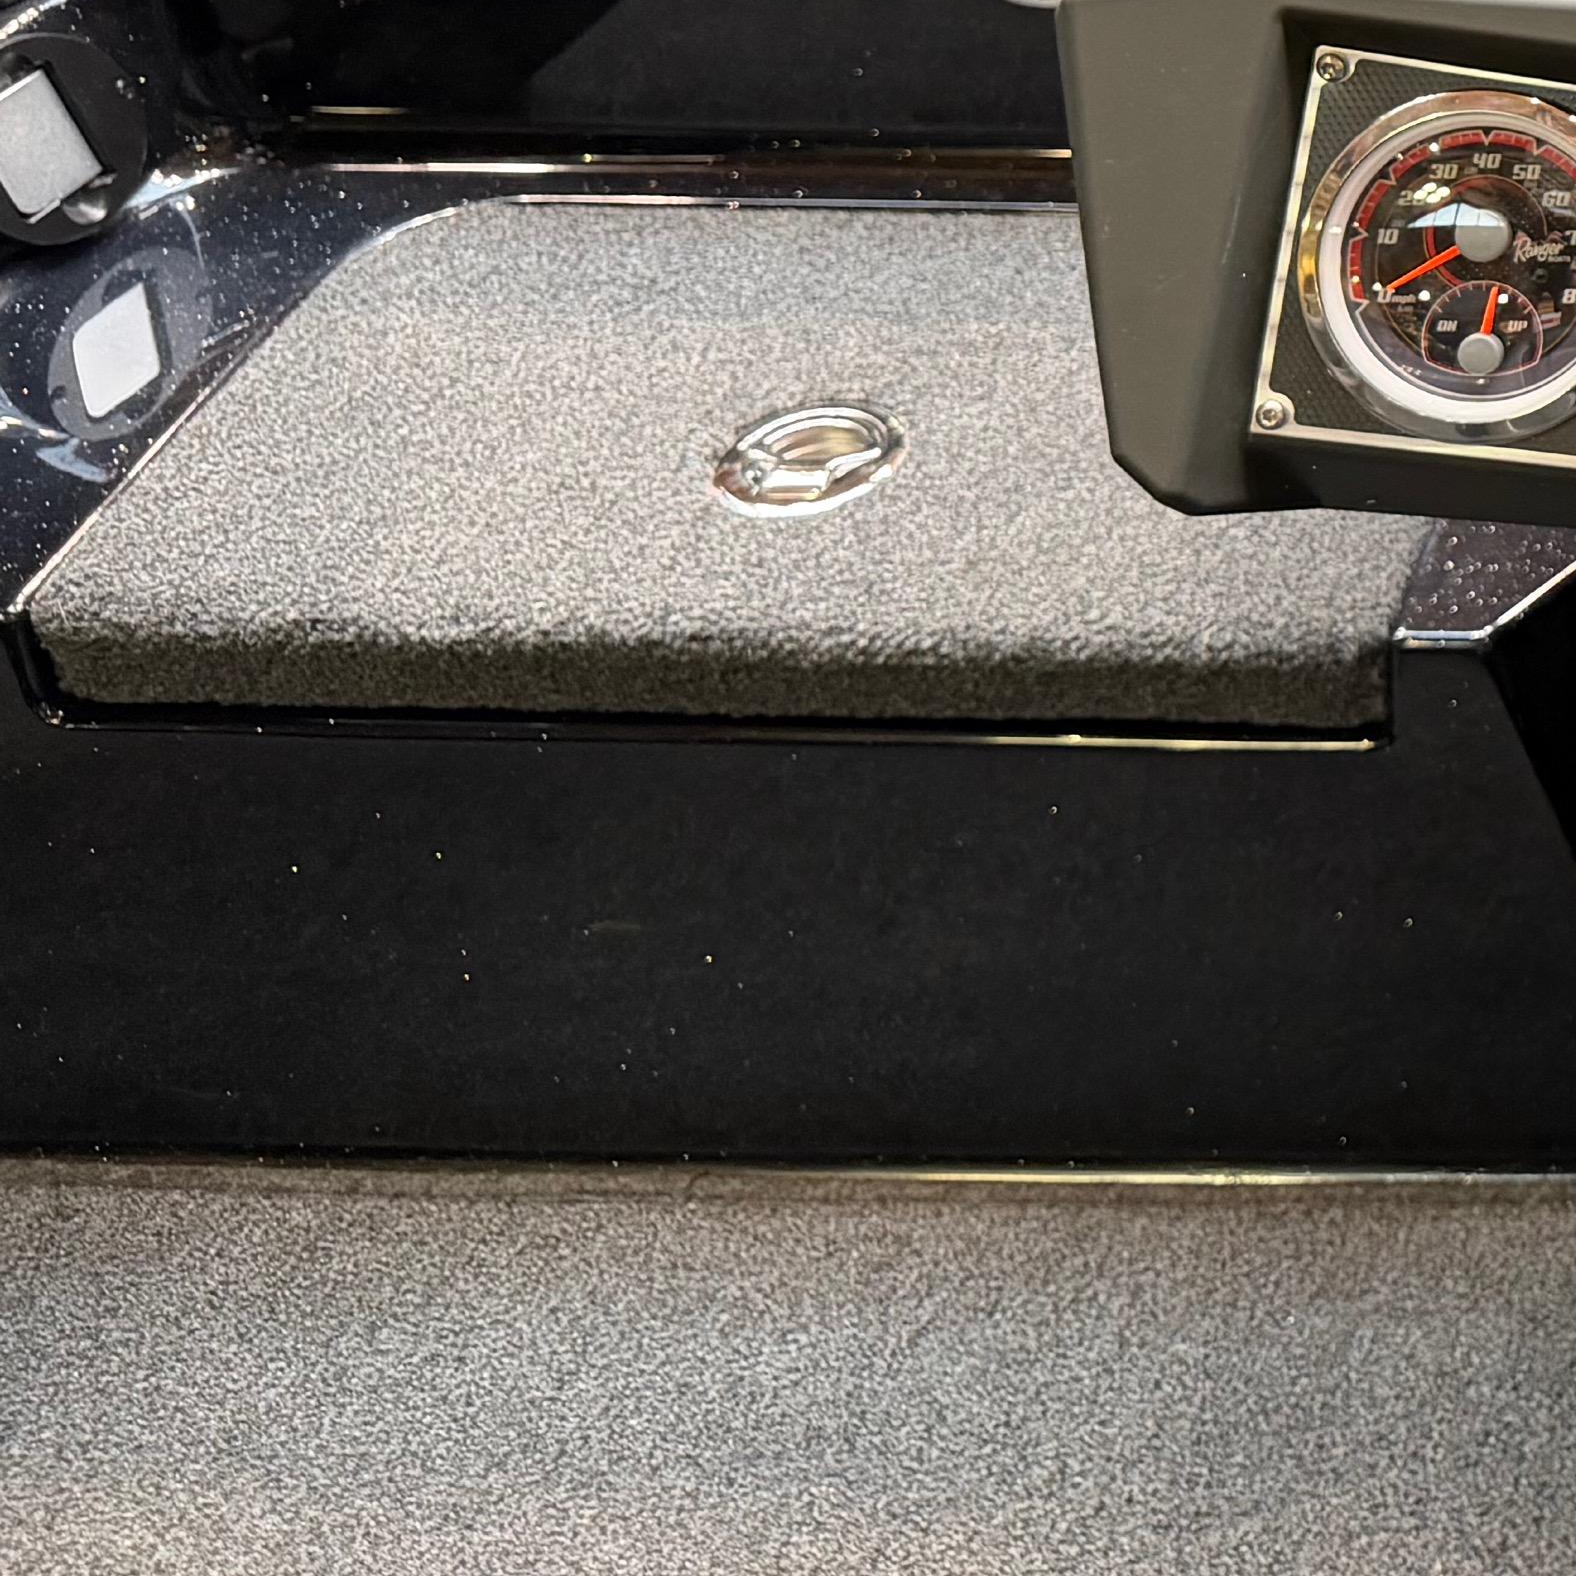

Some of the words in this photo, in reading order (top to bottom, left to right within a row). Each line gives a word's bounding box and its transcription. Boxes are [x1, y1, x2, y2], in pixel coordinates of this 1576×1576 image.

[1472, 153, 1503, 169] 40
[1429, 163, 1459, 180] 30
[1512, 164, 1541, 180] 50
[1541, 190, 1571, 208] 60
[1377, 228, 1400, 245] 10
[1513, 232, 1567, 264] Ranger
